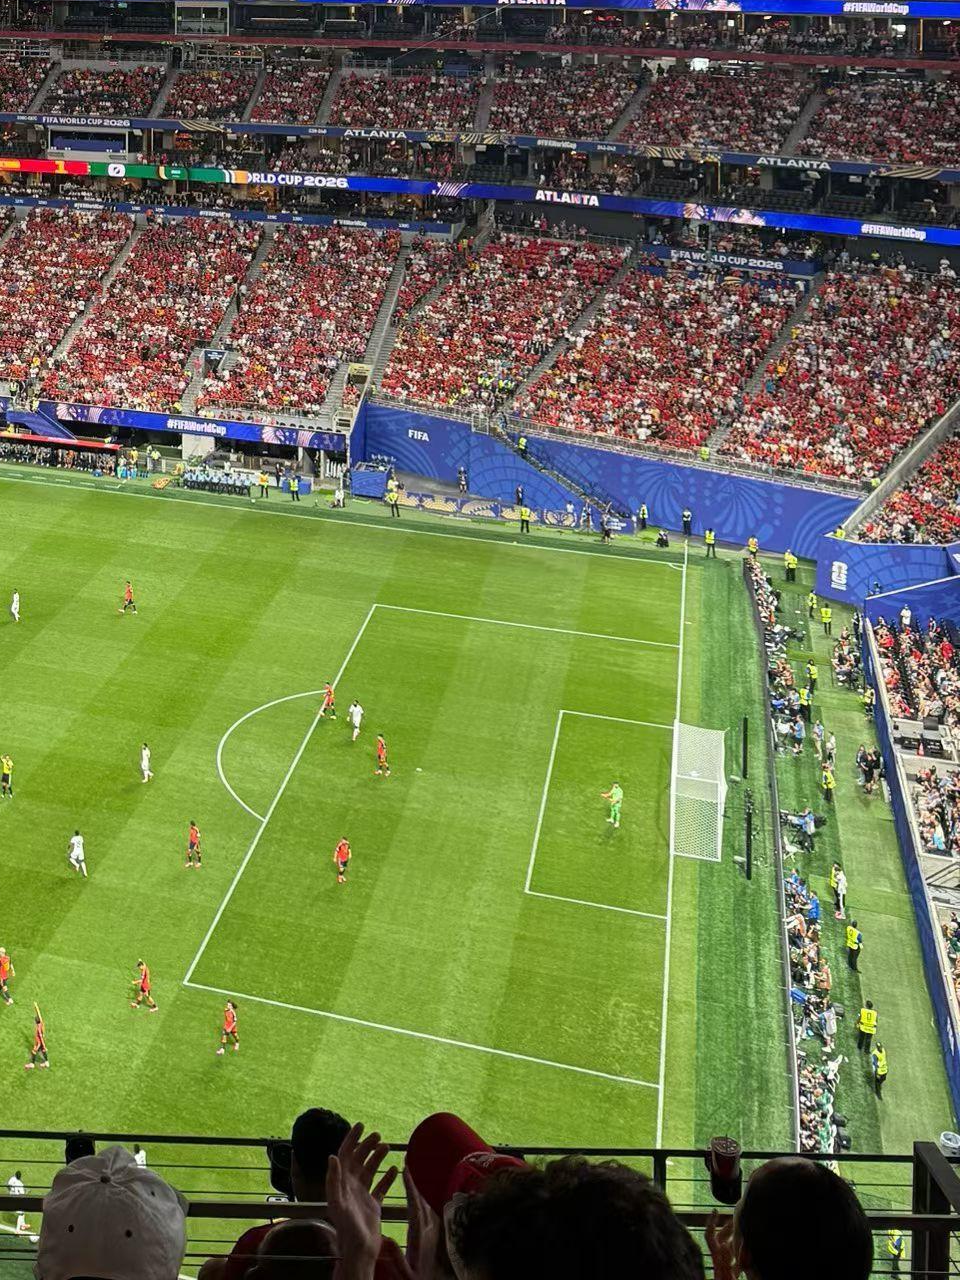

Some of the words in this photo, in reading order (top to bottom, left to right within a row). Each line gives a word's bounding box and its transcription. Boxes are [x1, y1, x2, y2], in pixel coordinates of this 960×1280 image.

[843, 1, 910, 15] #FIFAWorldCup
[42, 116, 58, 124] FIFA
[59, 117, 87, 125] WORLD
[344, 129, 407, 139] ATLANTA
[756, 156, 832, 170] ATLANTA
[277, 173, 303, 186] CUP
[303, 175, 349, 189] 2026
[535, 189, 600, 207] ATLANTA
[861, 223, 926, 241] #FIFAWorldCup
[727, 256, 748, 265] CUP
[748, 258, 784, 270] 2026
[167, 419, 227, 436] #FIFAWorldCup
[408, 429, 430, 442] FIFA
